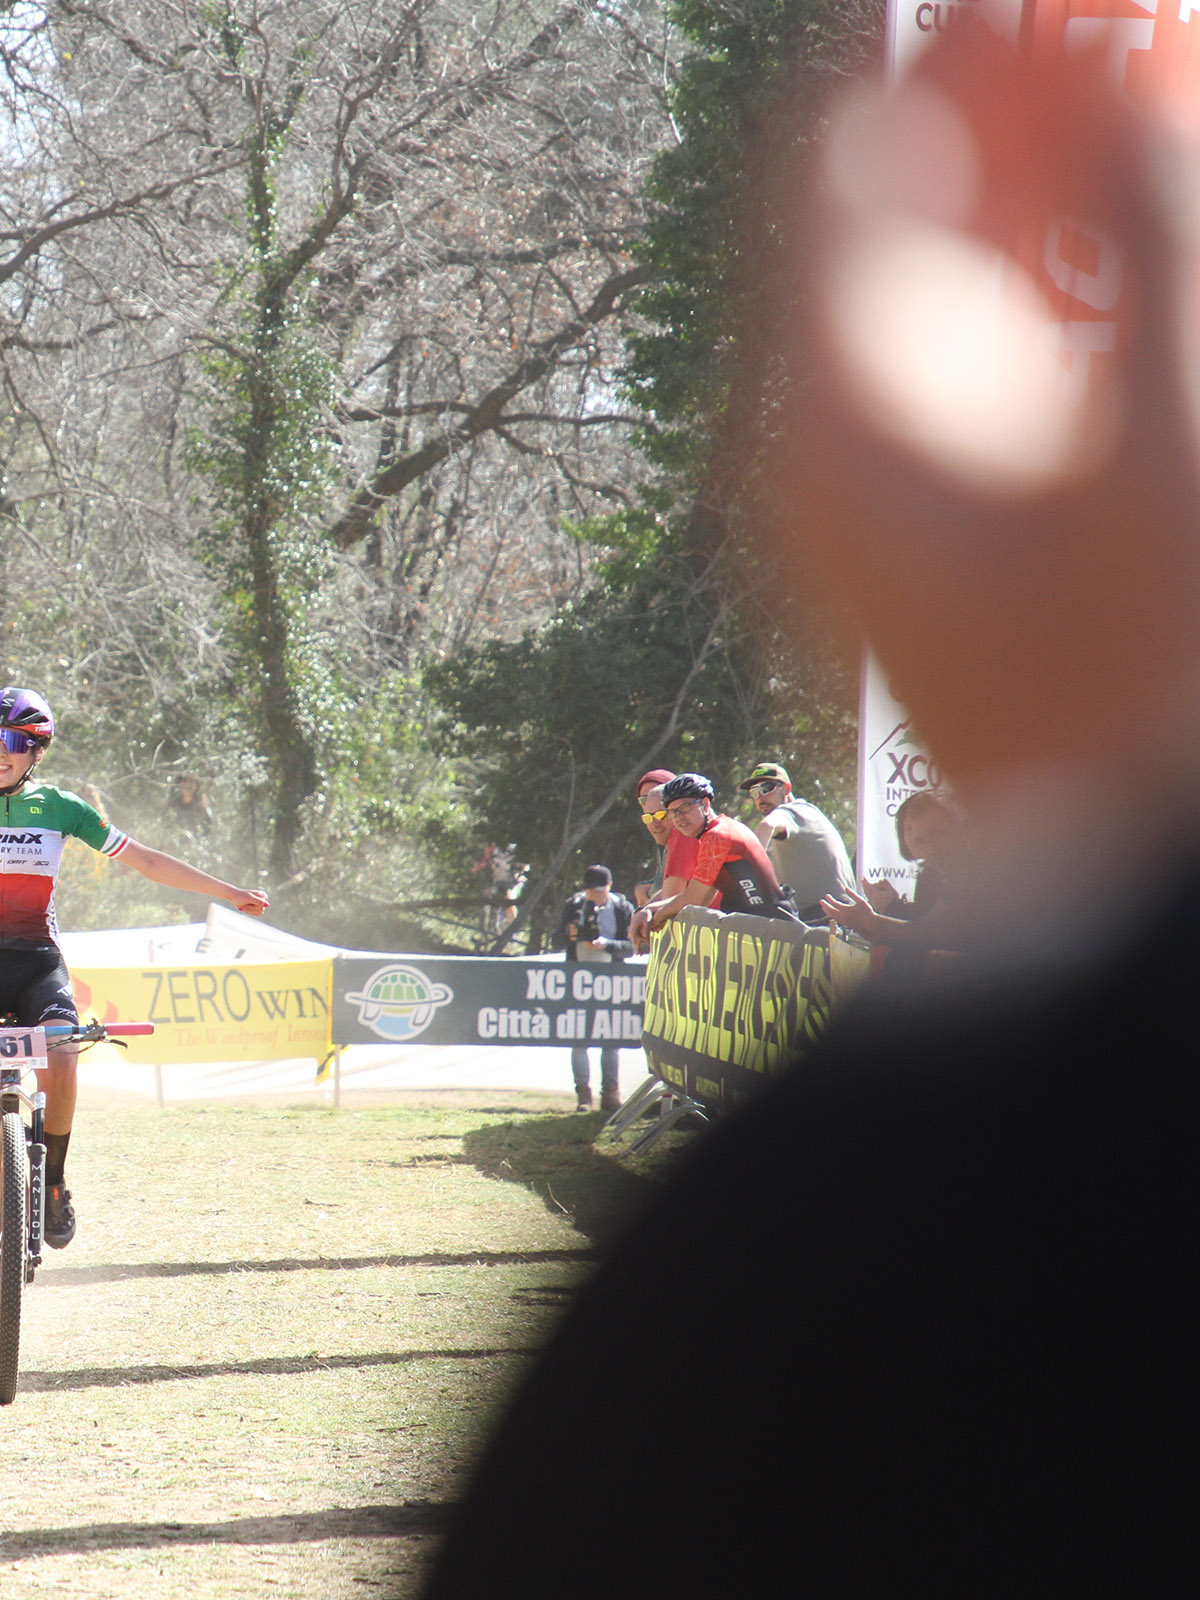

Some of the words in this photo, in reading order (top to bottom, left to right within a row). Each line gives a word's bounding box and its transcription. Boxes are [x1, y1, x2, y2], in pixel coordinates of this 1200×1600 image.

[16, 847, 42, 856] TEAM
[141, 969, 251, 1024] ZERO
[526, 969, 557, 1001] XC
[477, 1006, 550, 1040] Città
[556, 1009, 587, 1040] di
[591, 1009, 643, 1041] Alb
[0, 1034, 33, 1058] 61
[31, 1164, 42, 1240] MANITOU
